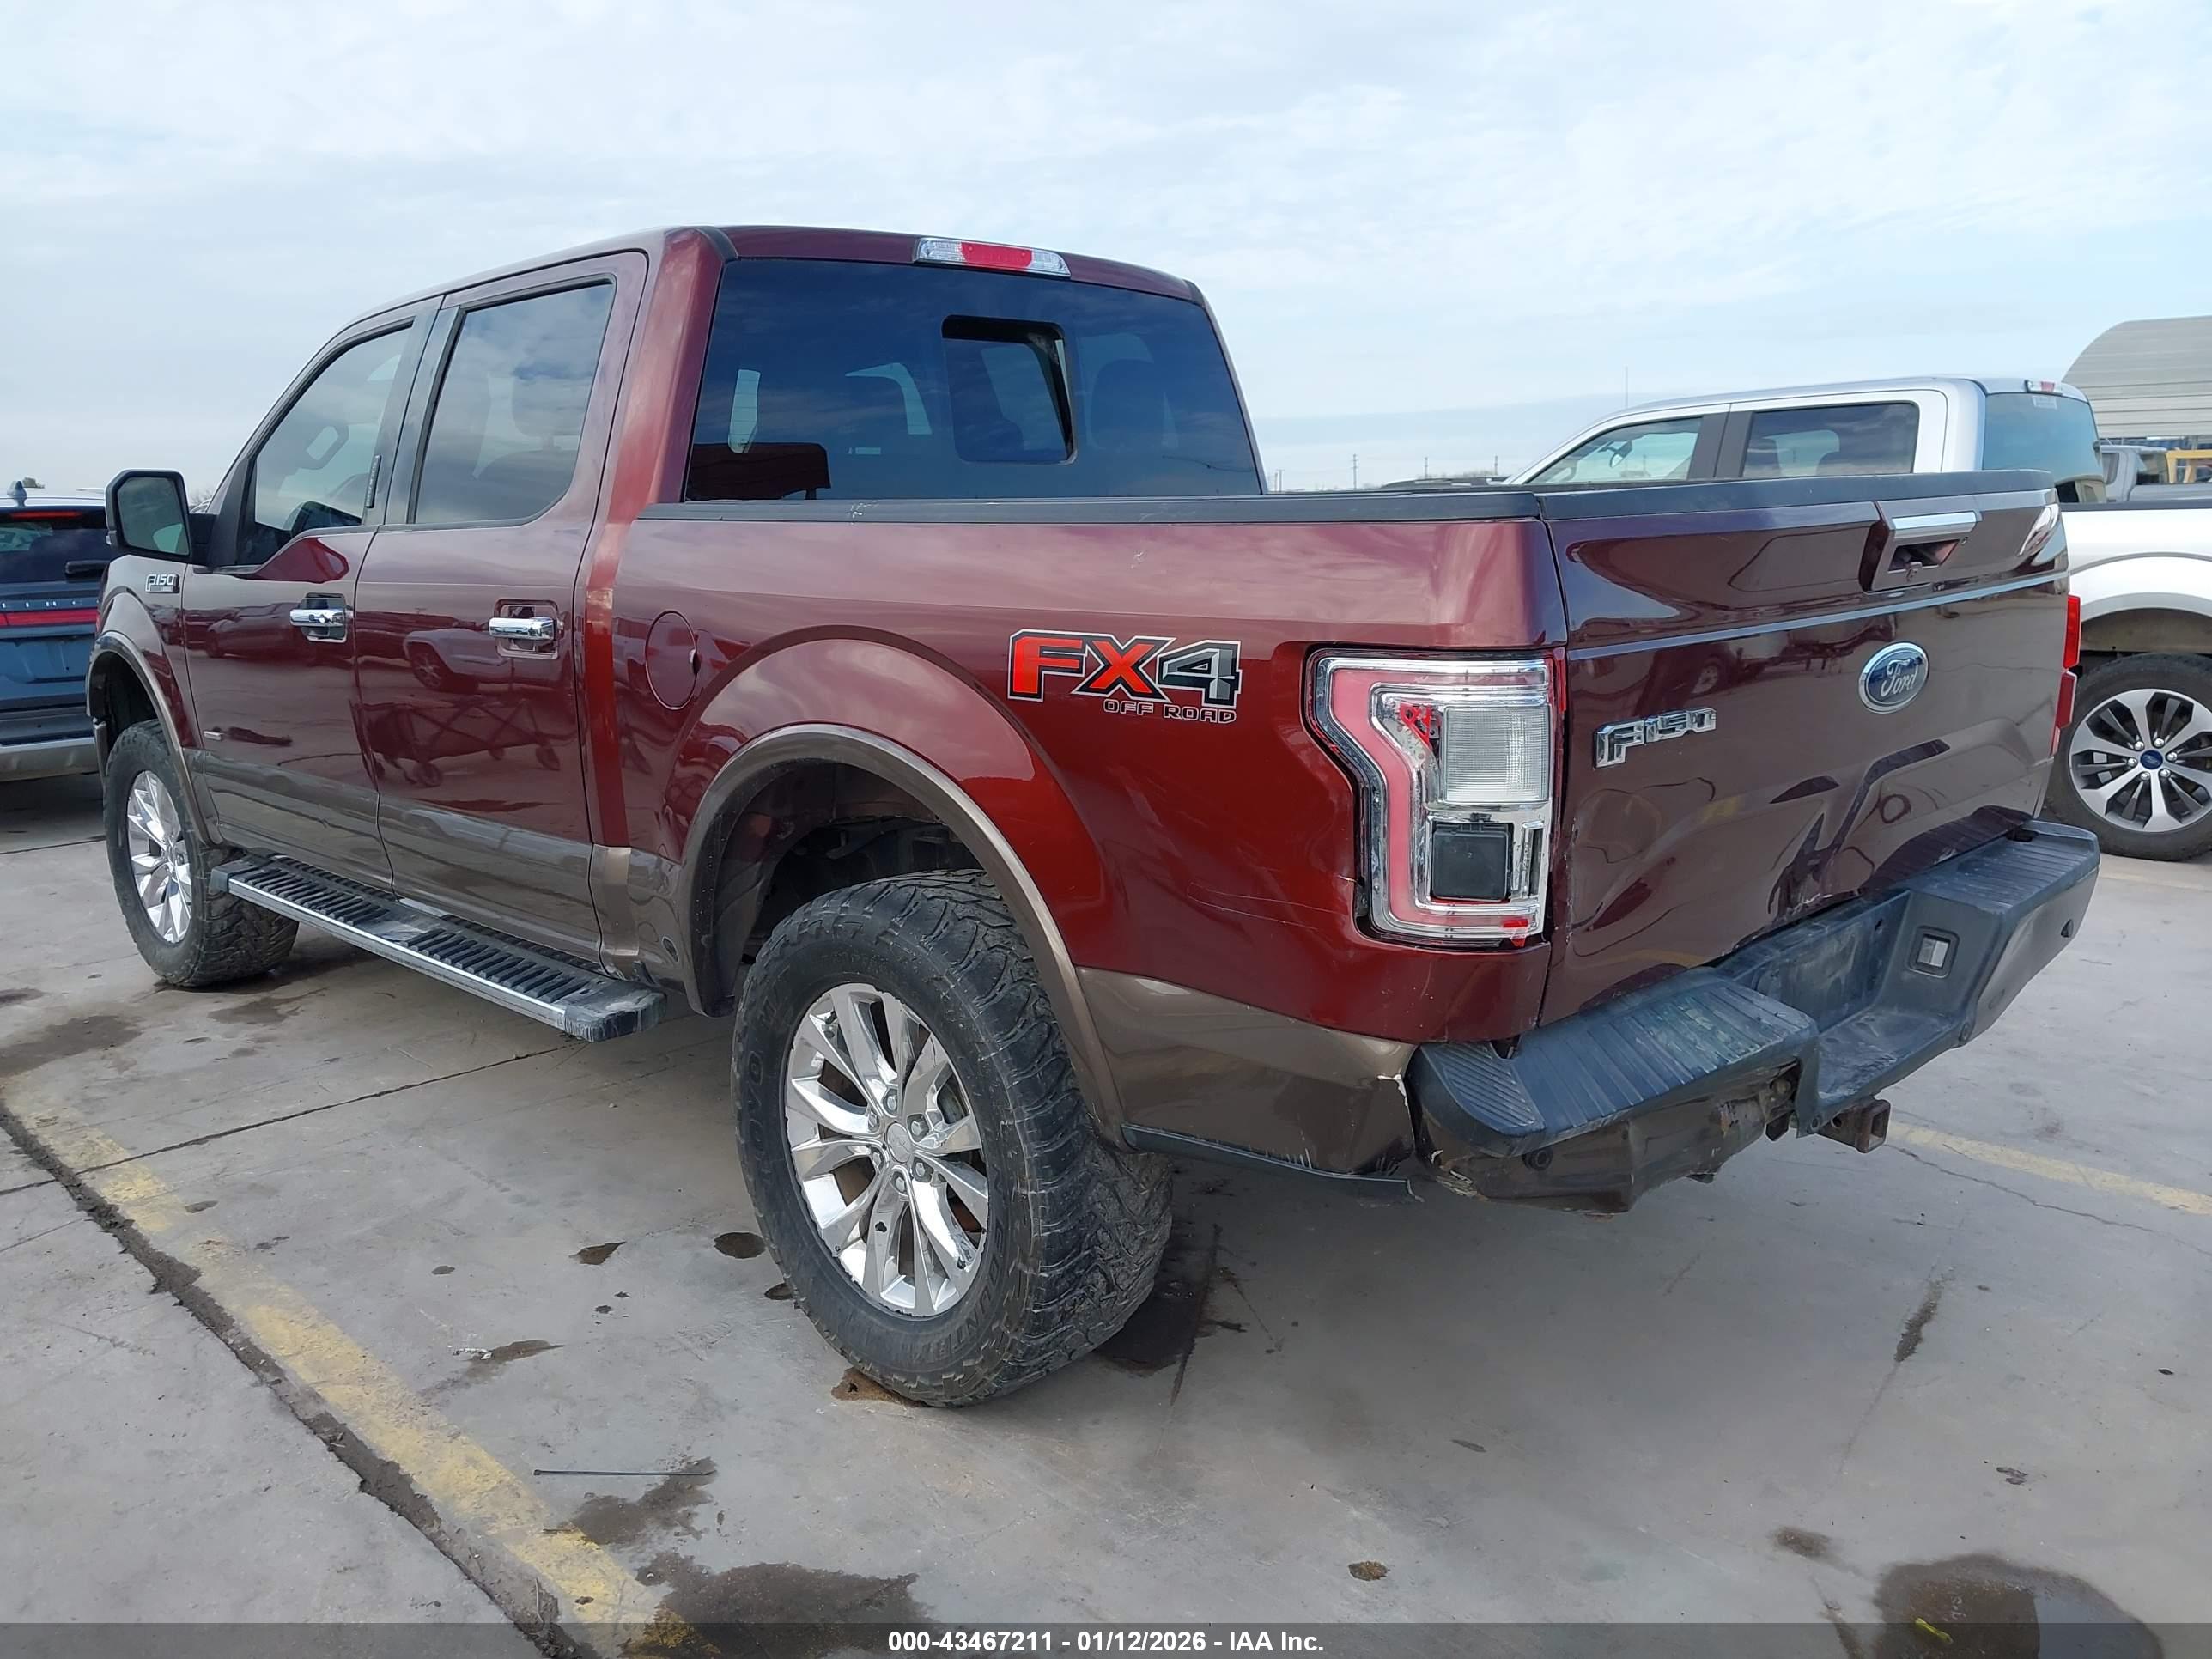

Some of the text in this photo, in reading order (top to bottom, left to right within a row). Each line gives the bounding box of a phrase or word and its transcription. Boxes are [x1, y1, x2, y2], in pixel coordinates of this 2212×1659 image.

[1007, 629, 1243, 709] FX4
[1881, 658, 1919, 696] Ford
[1103, 698, 1237, 724] OFF ROAD
